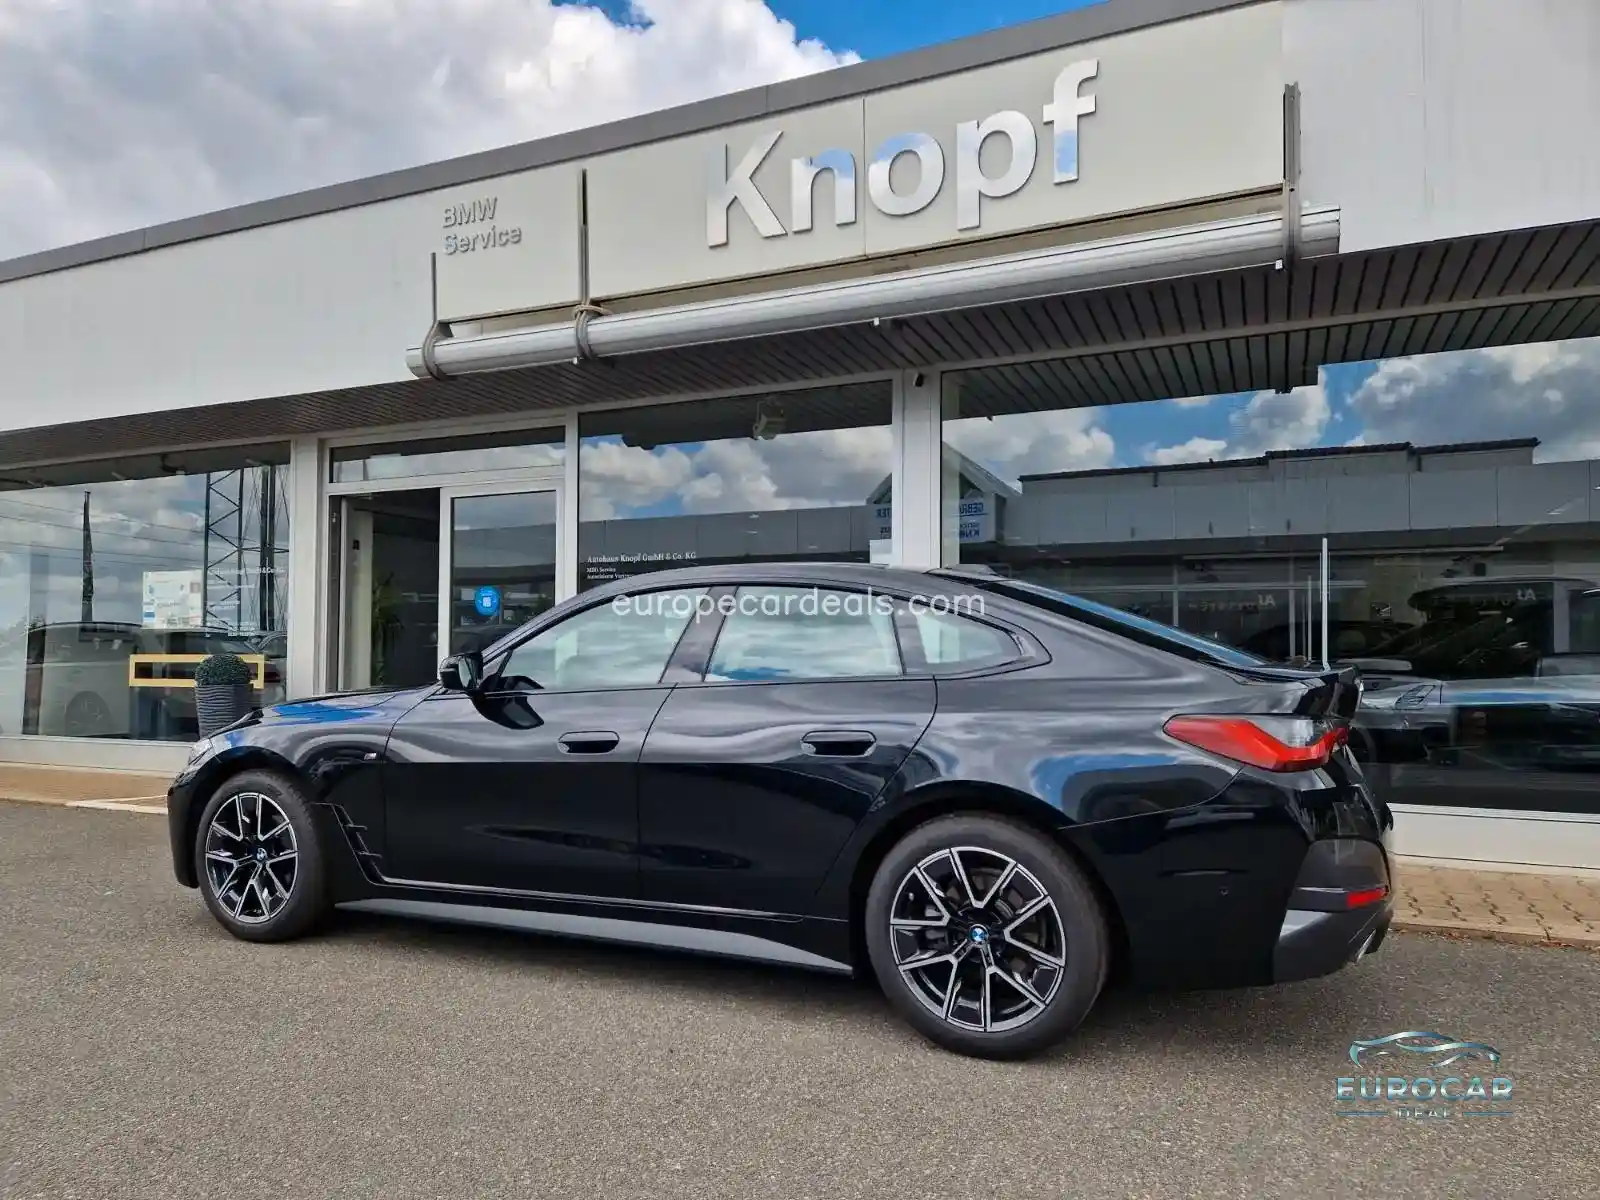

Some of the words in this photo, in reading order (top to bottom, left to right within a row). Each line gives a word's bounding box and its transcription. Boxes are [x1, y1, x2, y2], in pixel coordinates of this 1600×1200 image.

[706, 58, 1100, 249] Knopf
[442, 197, 498, 229] BMW
[444, 226, 522, 256] Service
[587, 554, 619, 563] Autohaus
[620, 553, 641, 563] Knopf
[642, 552, 664, 562] GmbH
[665, 552, 671, 560] &
[685, 551, 697, 559] KG
